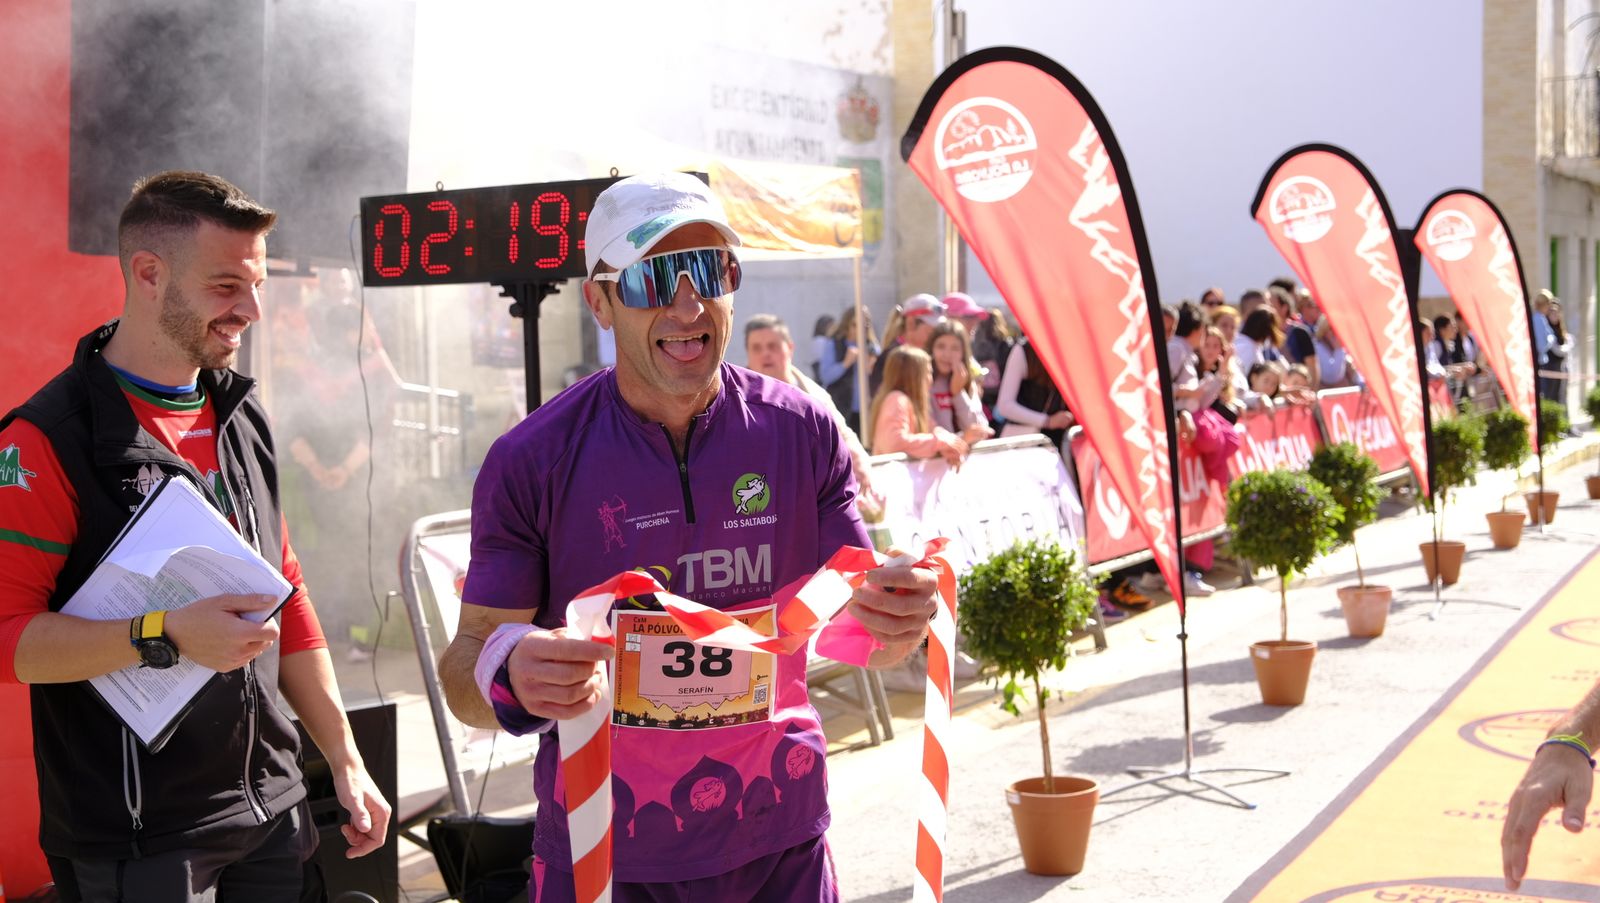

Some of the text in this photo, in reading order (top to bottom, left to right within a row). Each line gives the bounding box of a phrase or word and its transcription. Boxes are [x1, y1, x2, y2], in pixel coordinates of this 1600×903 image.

[636, 517, 670, 530] PURCHENA
[723, 518, 739, 529] LOS
[676, 544, 772, 593] TBM
[633, 623, 645, 633] LA
[661, 640, 733, 678] 38
[678, 685, 714, 695] SERAFÍN
